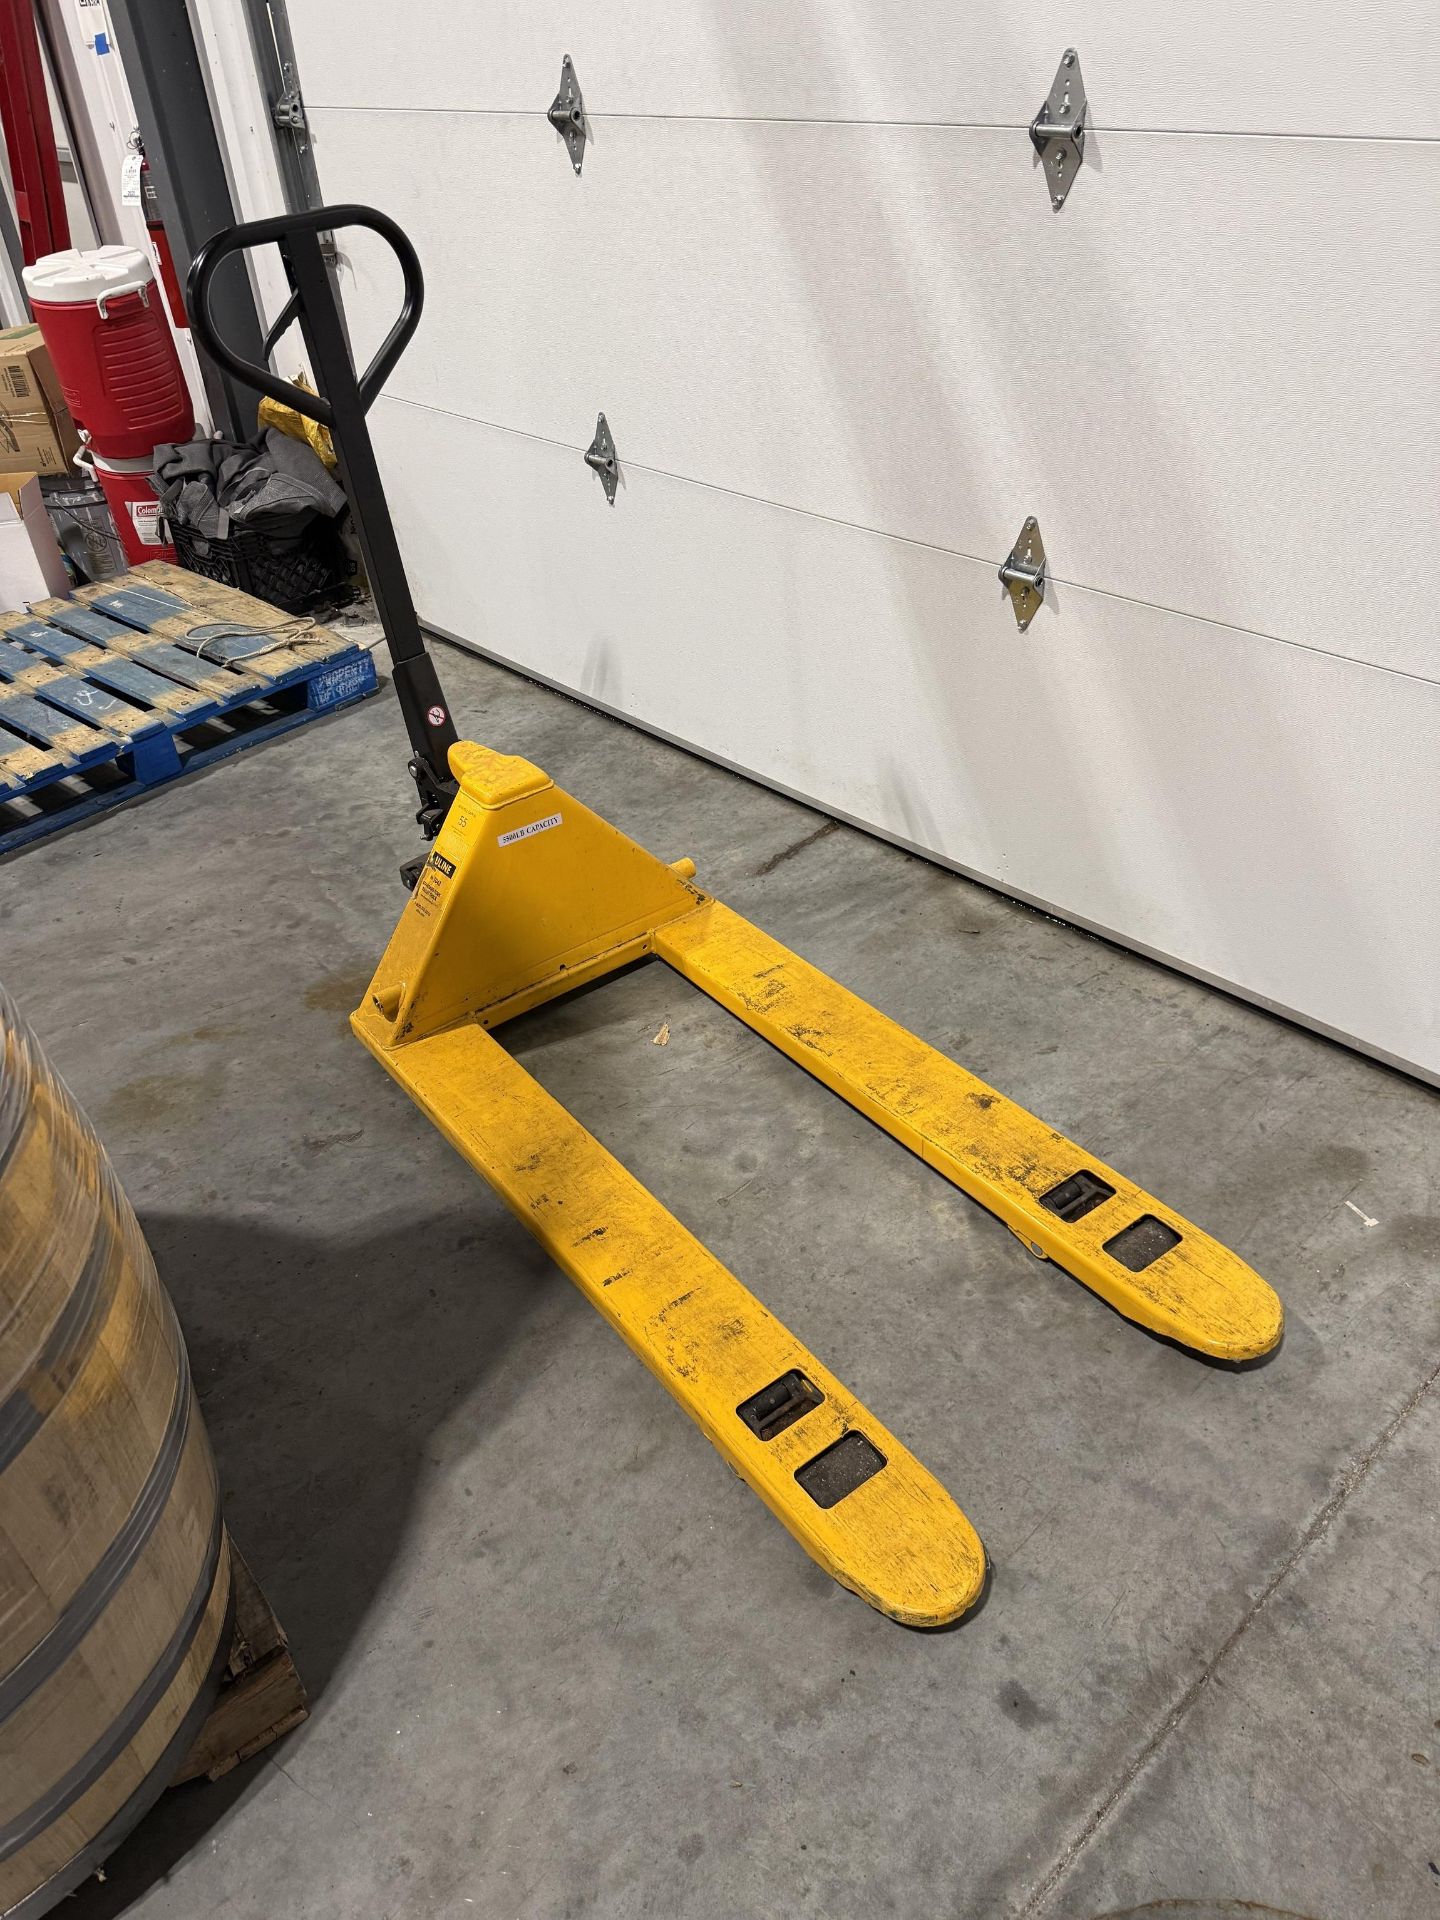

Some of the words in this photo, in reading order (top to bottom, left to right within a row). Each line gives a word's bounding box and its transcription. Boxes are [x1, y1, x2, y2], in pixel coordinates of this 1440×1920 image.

[138, 506, 163, 514] Colem
[526, 816, 559, 834] CAPACITY
[434, 855, 453, 875] ULINE
